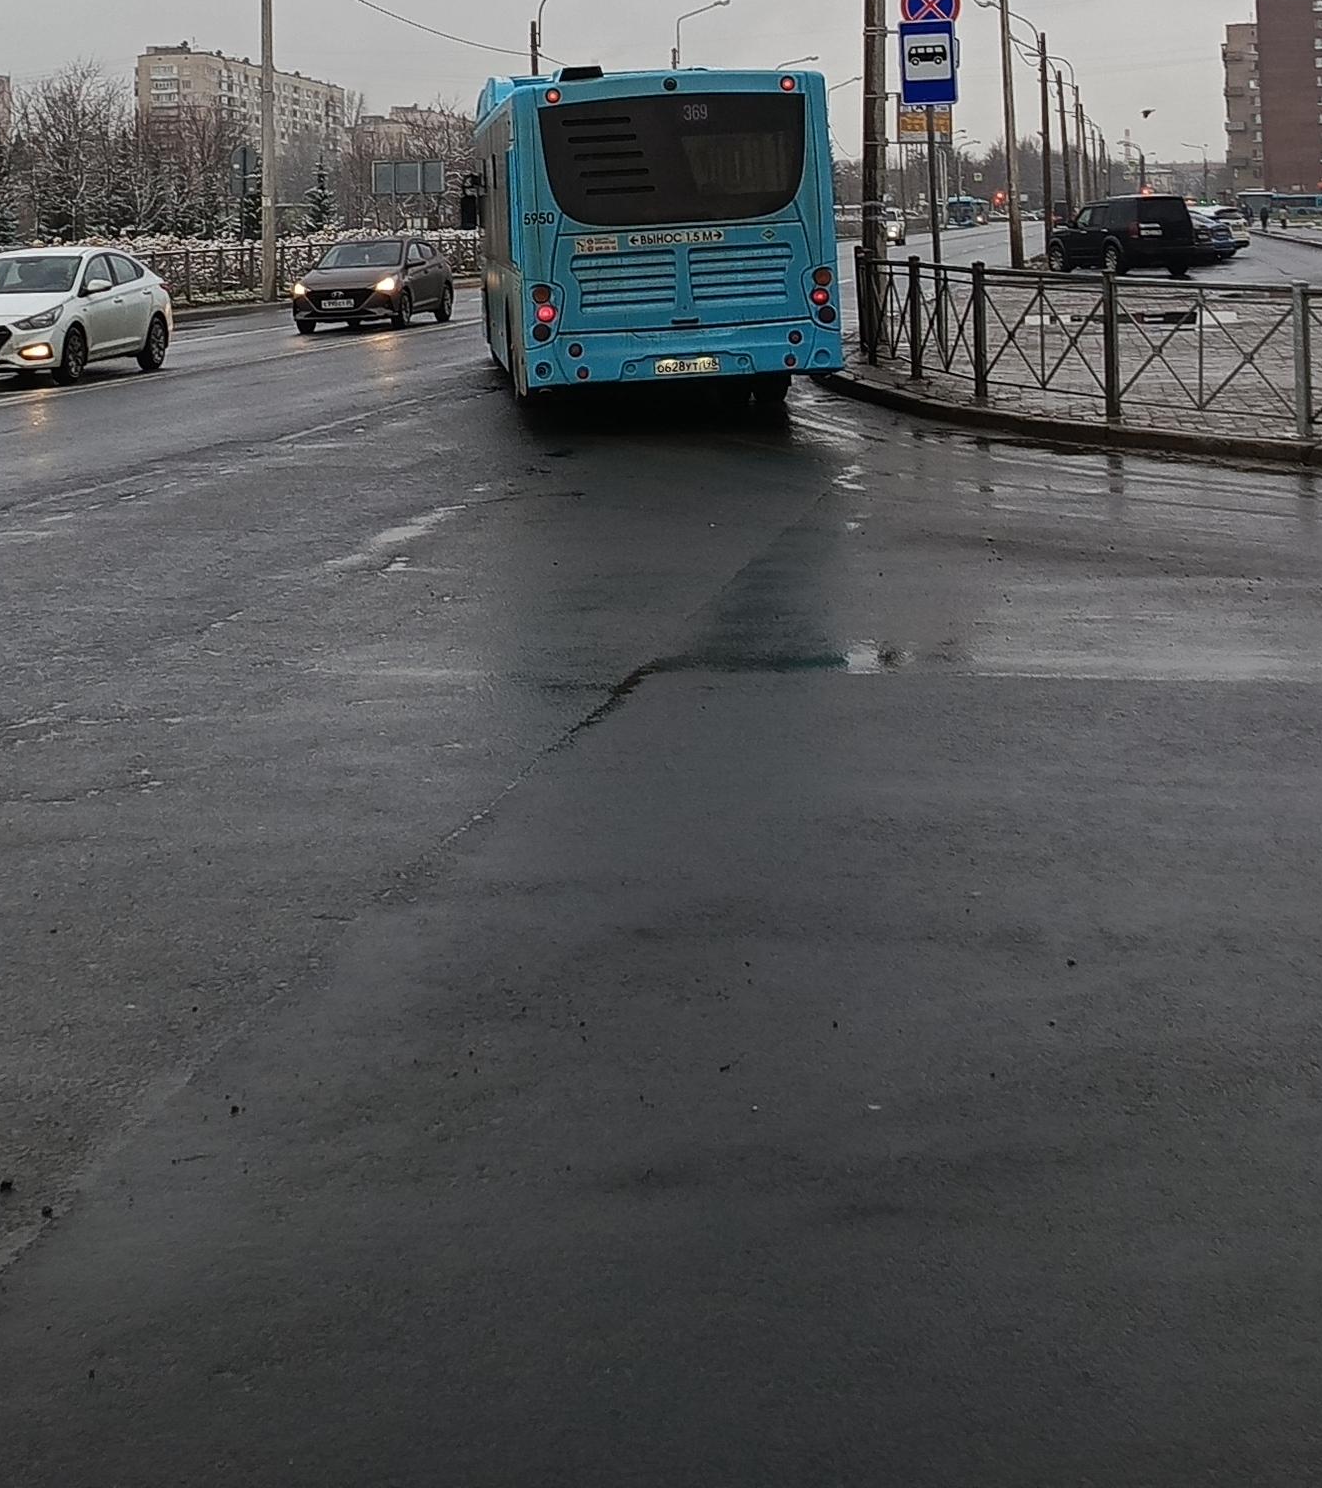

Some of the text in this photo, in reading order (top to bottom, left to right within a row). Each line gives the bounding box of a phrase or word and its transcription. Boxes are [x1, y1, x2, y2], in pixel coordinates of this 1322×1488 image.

[683, 103, 708, 121] 369
[523, 212, 555, 225] 5950
[640, 231, 713, 245] ВЫНОС 1,5 М
